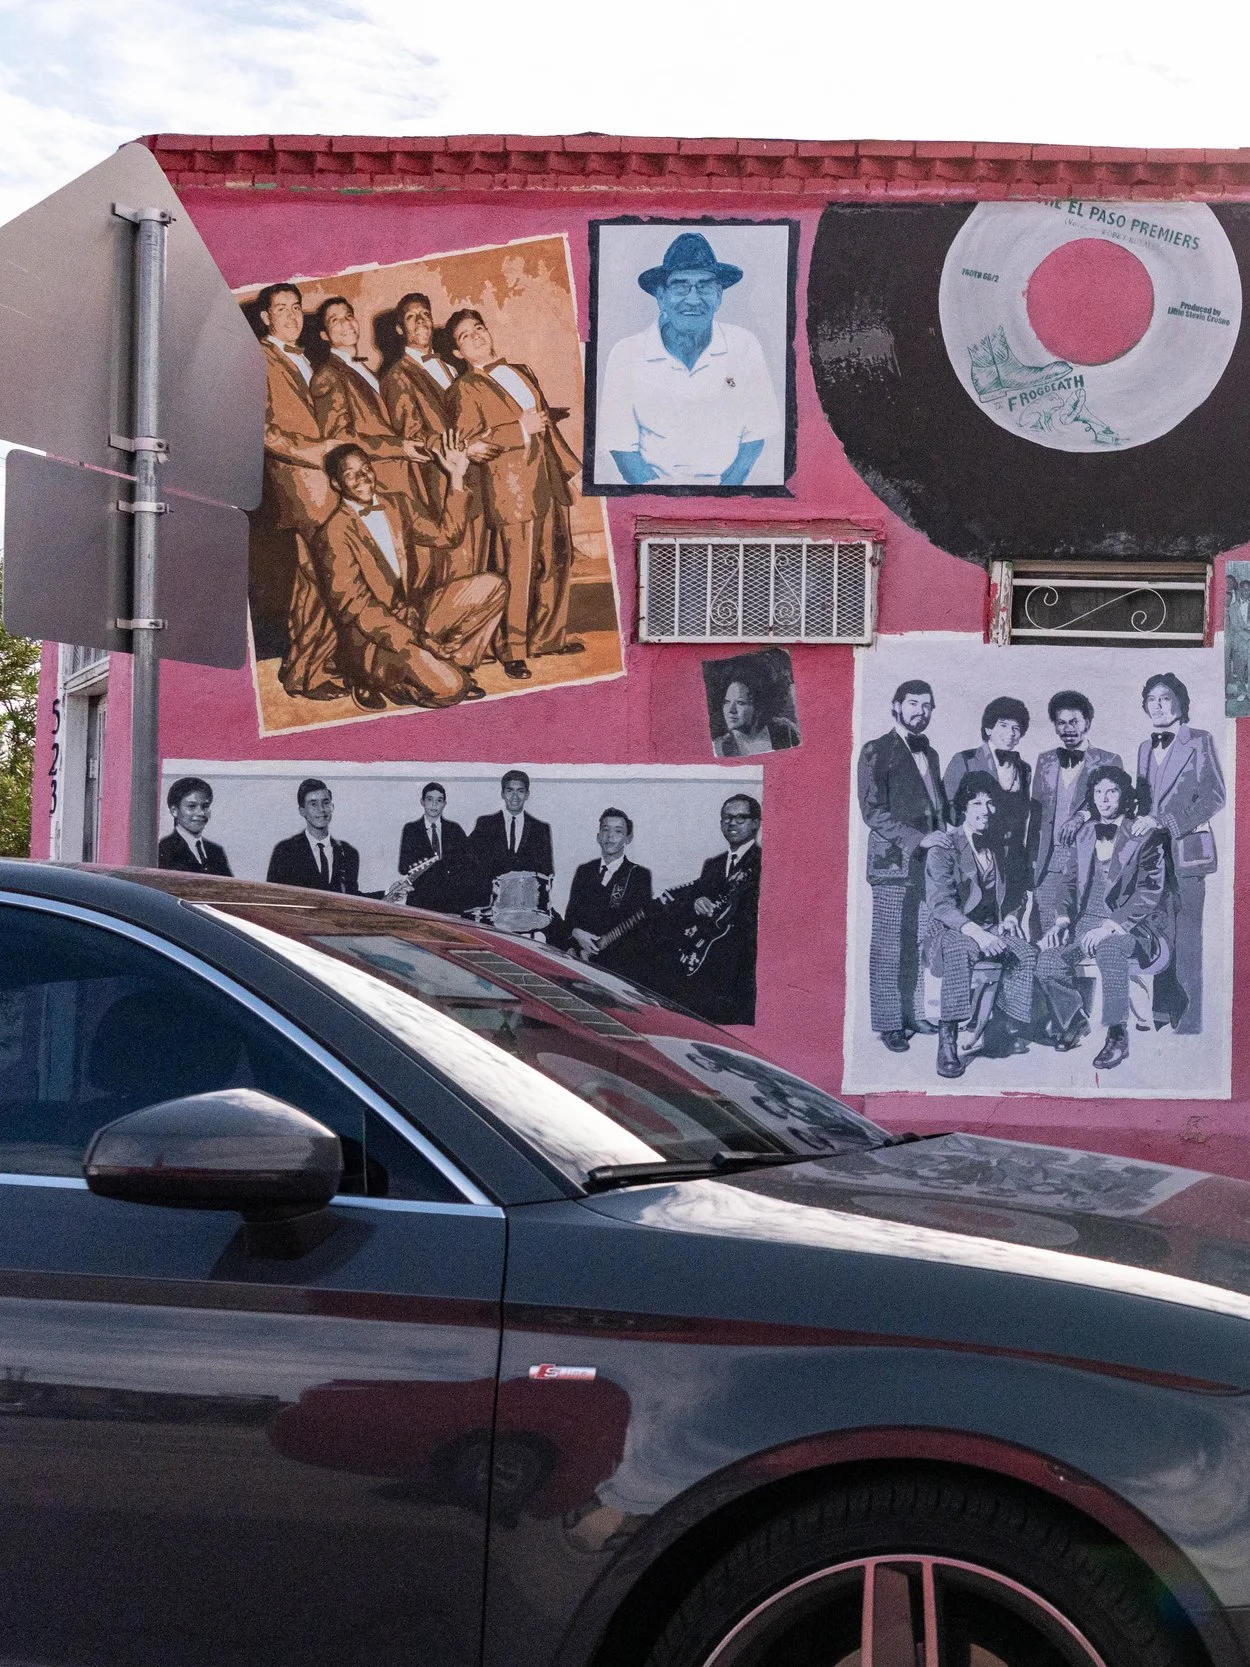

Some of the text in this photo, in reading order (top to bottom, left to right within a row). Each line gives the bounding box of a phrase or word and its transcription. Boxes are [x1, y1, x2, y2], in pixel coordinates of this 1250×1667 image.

[1067, 198, 1084, 218] EL
[1089, 205, 1127, 229] PASO
[1130, 218, 1201, 251] PREMIERS
[1180, 301, 1222, 317] Produced by
[1185, 310, 1206, 321] Stevie
[1008, 374, 1085, 412] FROGDEATH
